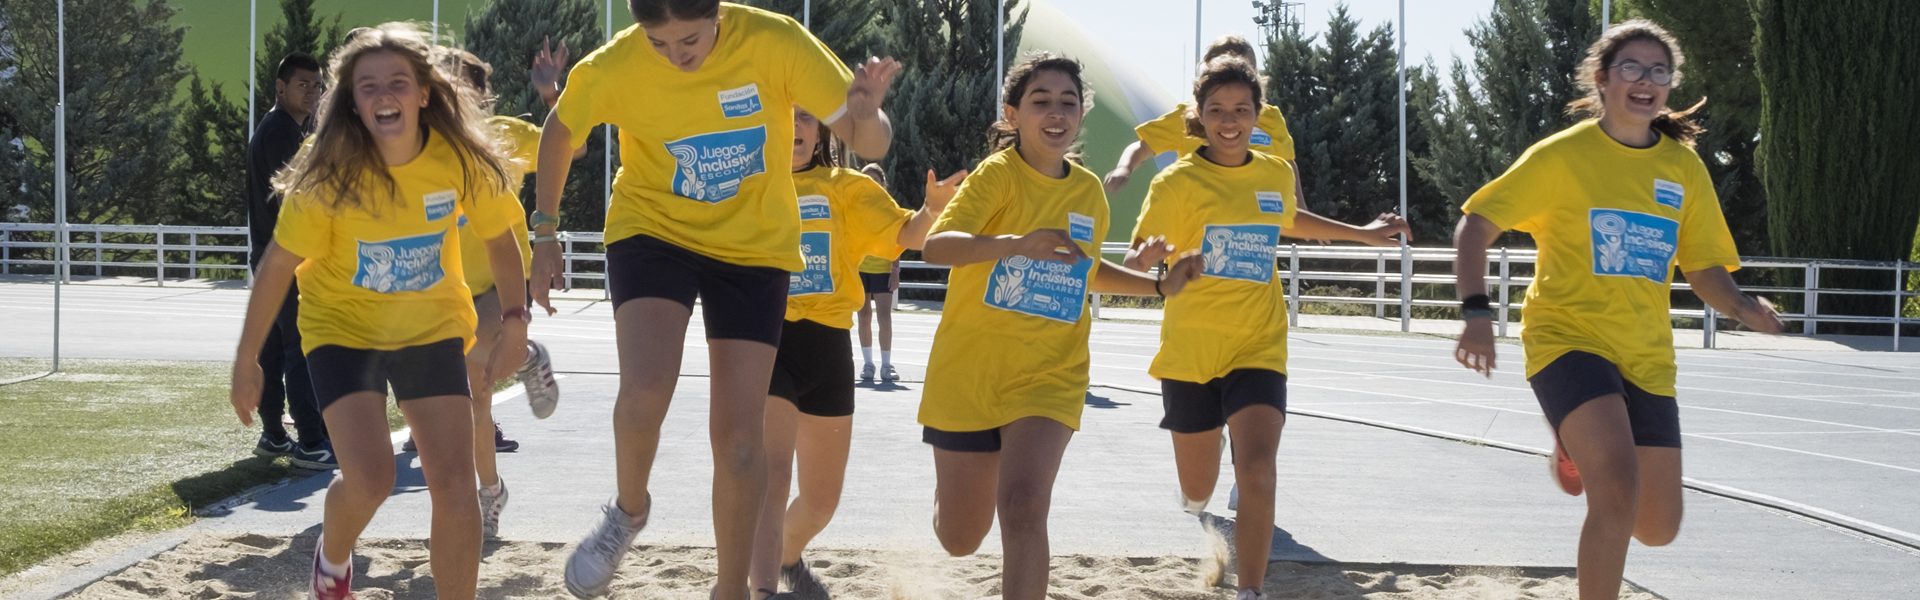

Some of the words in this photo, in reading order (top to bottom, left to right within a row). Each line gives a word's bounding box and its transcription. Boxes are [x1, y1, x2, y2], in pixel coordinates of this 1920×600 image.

[720, 86, 756, 101] Fundación
[724, 103, 748, 112] Sanitas
[700, 144, 746, 160] Juegos
[698, 151, 757, 174] Inclusiv
[700, 165, 746, 181] ESCOLA
[1232, 231, 1269, 244] Juegos
[1626, 222, 1665, 239] Juegos
[1028, 267, 1084, 289] Inclusivos
[1026, 279, 1081, 297] ESCOLARES
